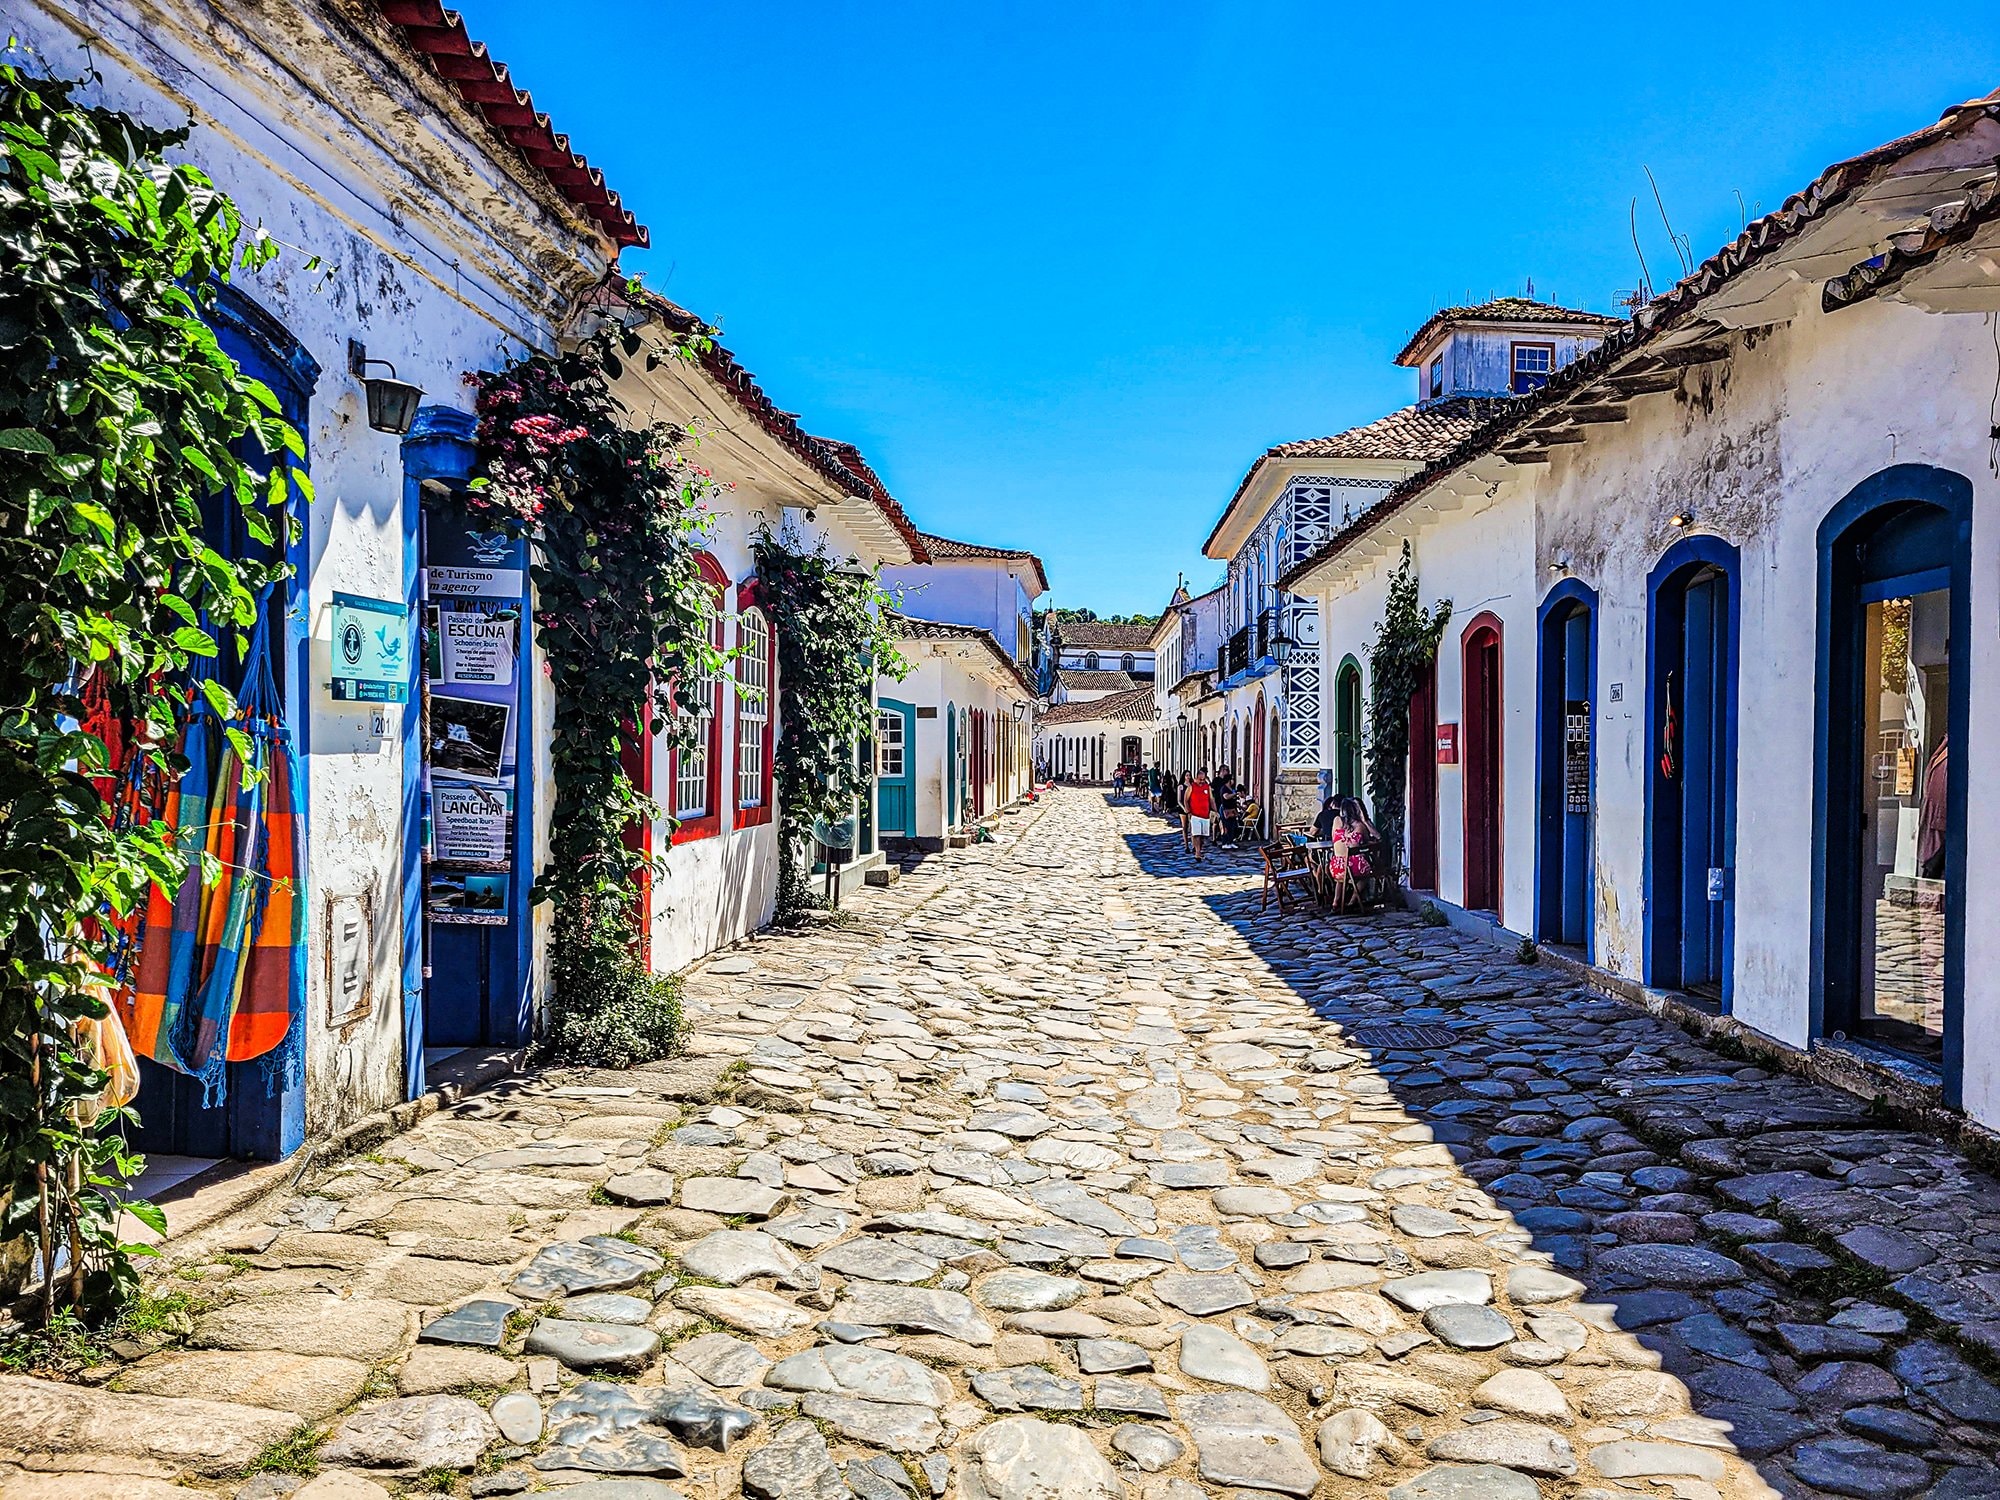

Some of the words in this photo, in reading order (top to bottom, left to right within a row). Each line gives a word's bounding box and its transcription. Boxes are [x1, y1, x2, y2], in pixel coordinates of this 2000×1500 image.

[430, 568, 445, 579] de
[447, 569, 493, 581] Turismo
[442, 583, 480, 595] agency
[447, 615, 473, 624] Passeio
[475, 616, 484, 624] de
[447, 624, 506, 639] ESCUNA
[454, 639, 482, 647] Schooner
[375, 716, 390, 734] 201
[441, 792, 467, 801] Passeio
[468, 793, 478, 801] de
[442, 801, 500, 815] LANCHA
[446, 816, 478, 825] Speedboat
[478, 817, 495, 825] Tours
